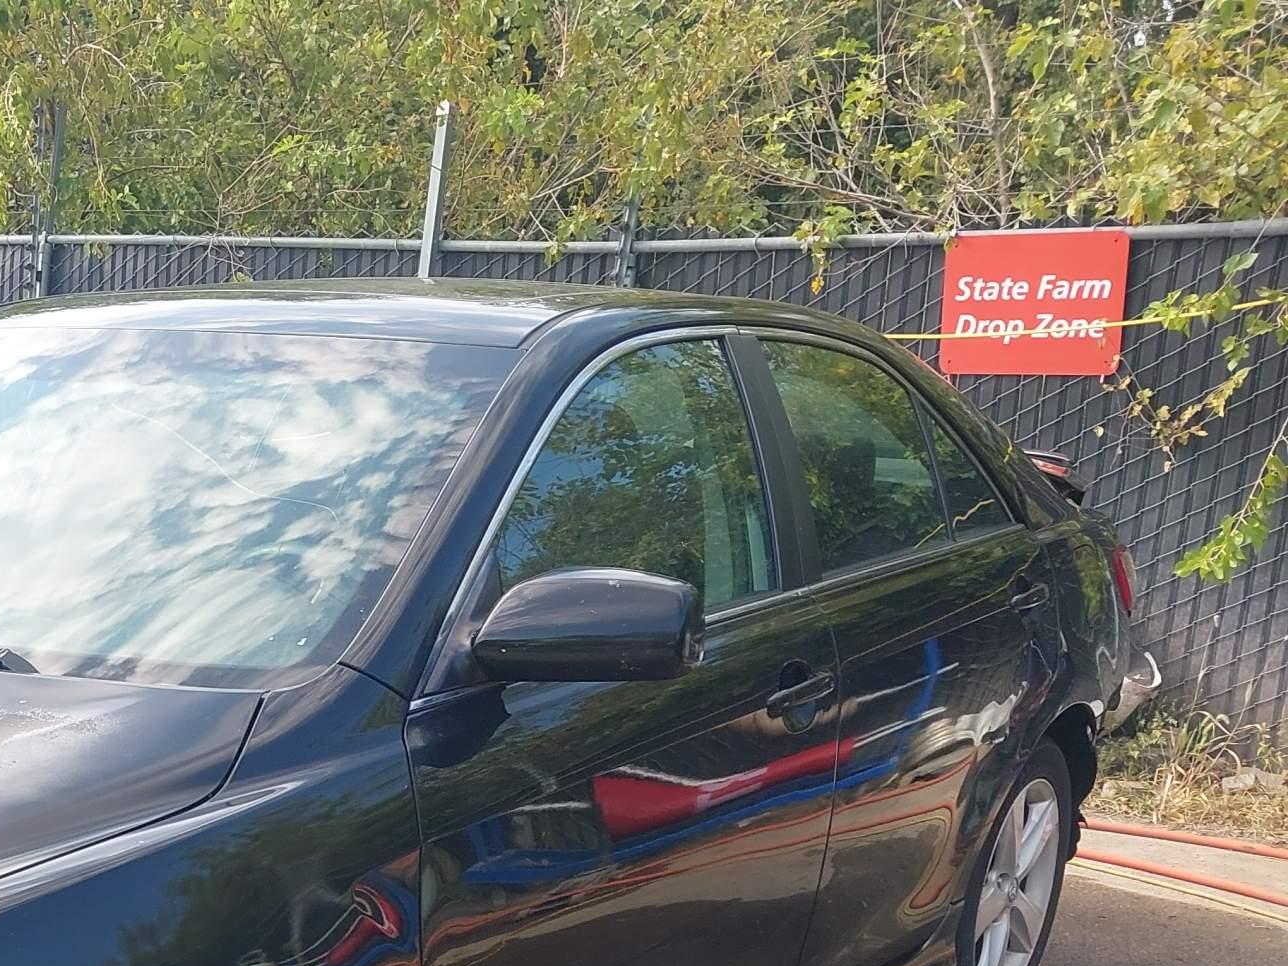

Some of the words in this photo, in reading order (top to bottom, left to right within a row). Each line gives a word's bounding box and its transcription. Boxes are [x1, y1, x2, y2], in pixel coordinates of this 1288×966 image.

[954, 276, 1029, 301] State
[1036, 274, 1112, 300] Farm
[955, 314, 1025, 345] Drop
[1031, 313, 1106, 338] Zone
